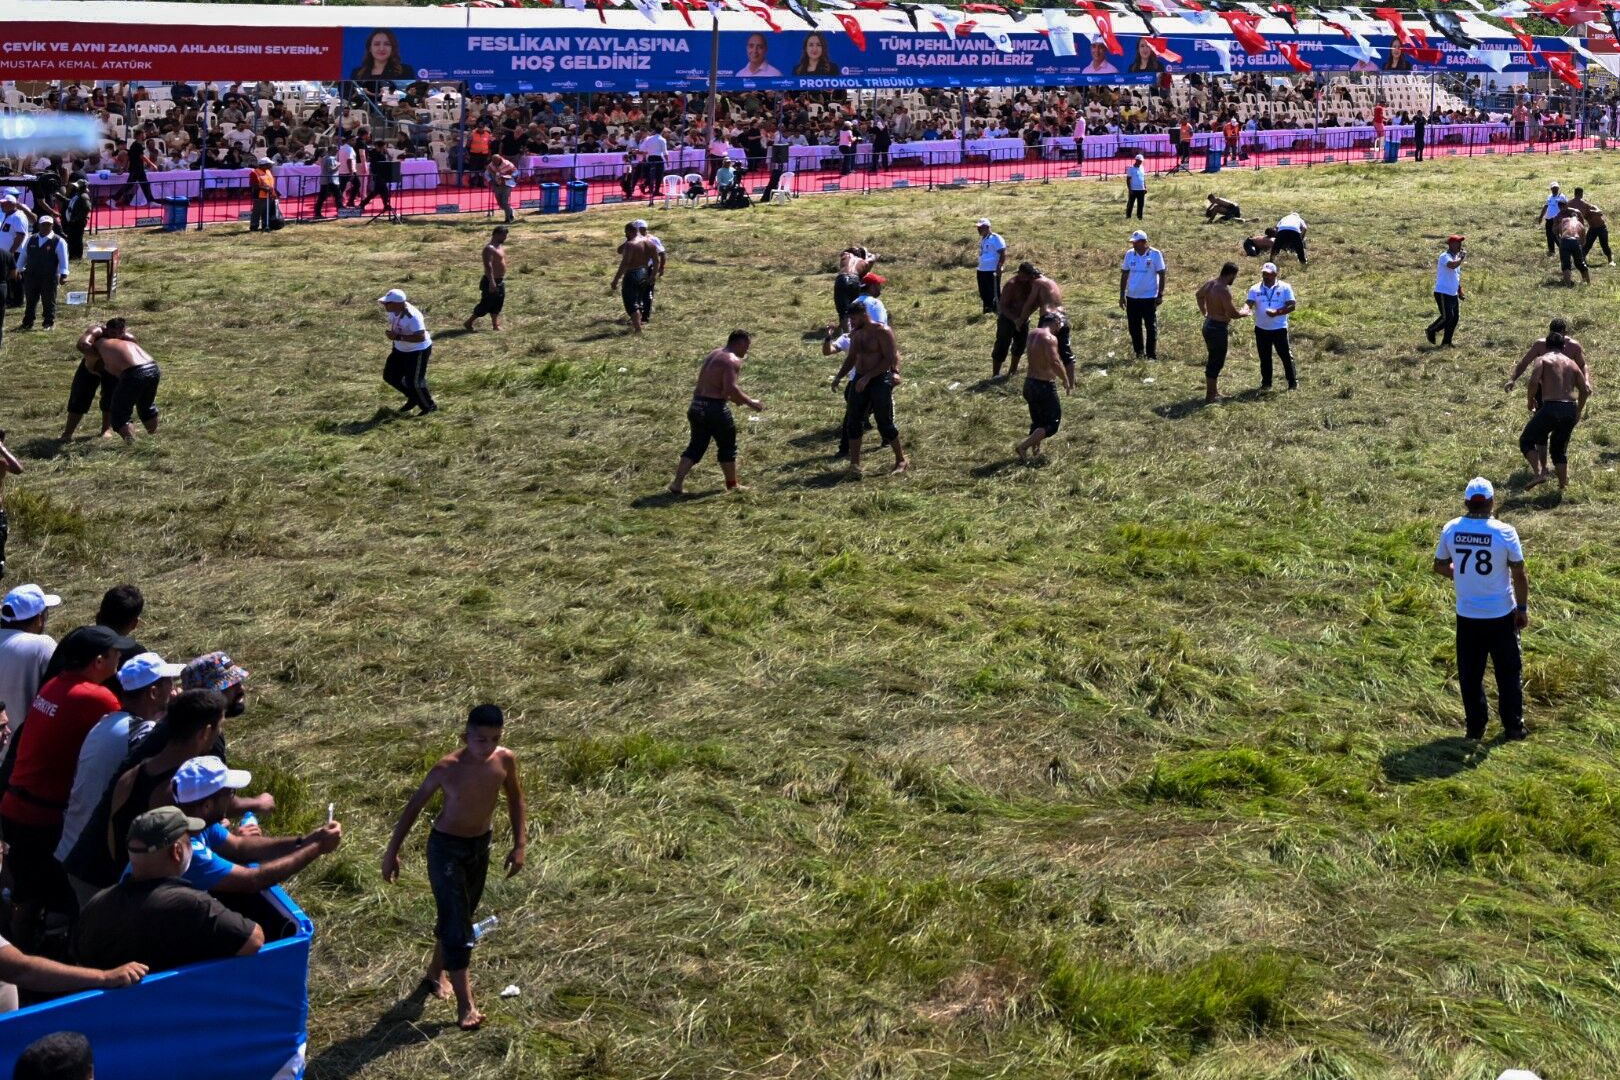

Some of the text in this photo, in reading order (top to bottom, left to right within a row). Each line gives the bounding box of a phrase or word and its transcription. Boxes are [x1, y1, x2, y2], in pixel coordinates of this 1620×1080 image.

[3, 41, 46, 54] ÇEVİK
[50, 42, 69, 52] VE
[72, 43, 105, 53] AYNI
[108, 43, 177, 53] ZAMANDA
[180, 44, 262, 54] AHLAKLISINI
[468, 33, 570, 51] FESLİKAN
[879, 36, 912, 51] TÜM
[0, 60, 152, 69] MUSTAFA KEMAL ATATÜRK
[511, 52, 651, 72] HOŞ GELDİNİZ
[896, 52, 1034, 67] BAŞARILAR DİLERİZ
[800, 78, 862, 88] PROTOKOL
[864, 76, 914, 87] TRİBÜNÜ
[1455, 548, 1492, 575] 78
